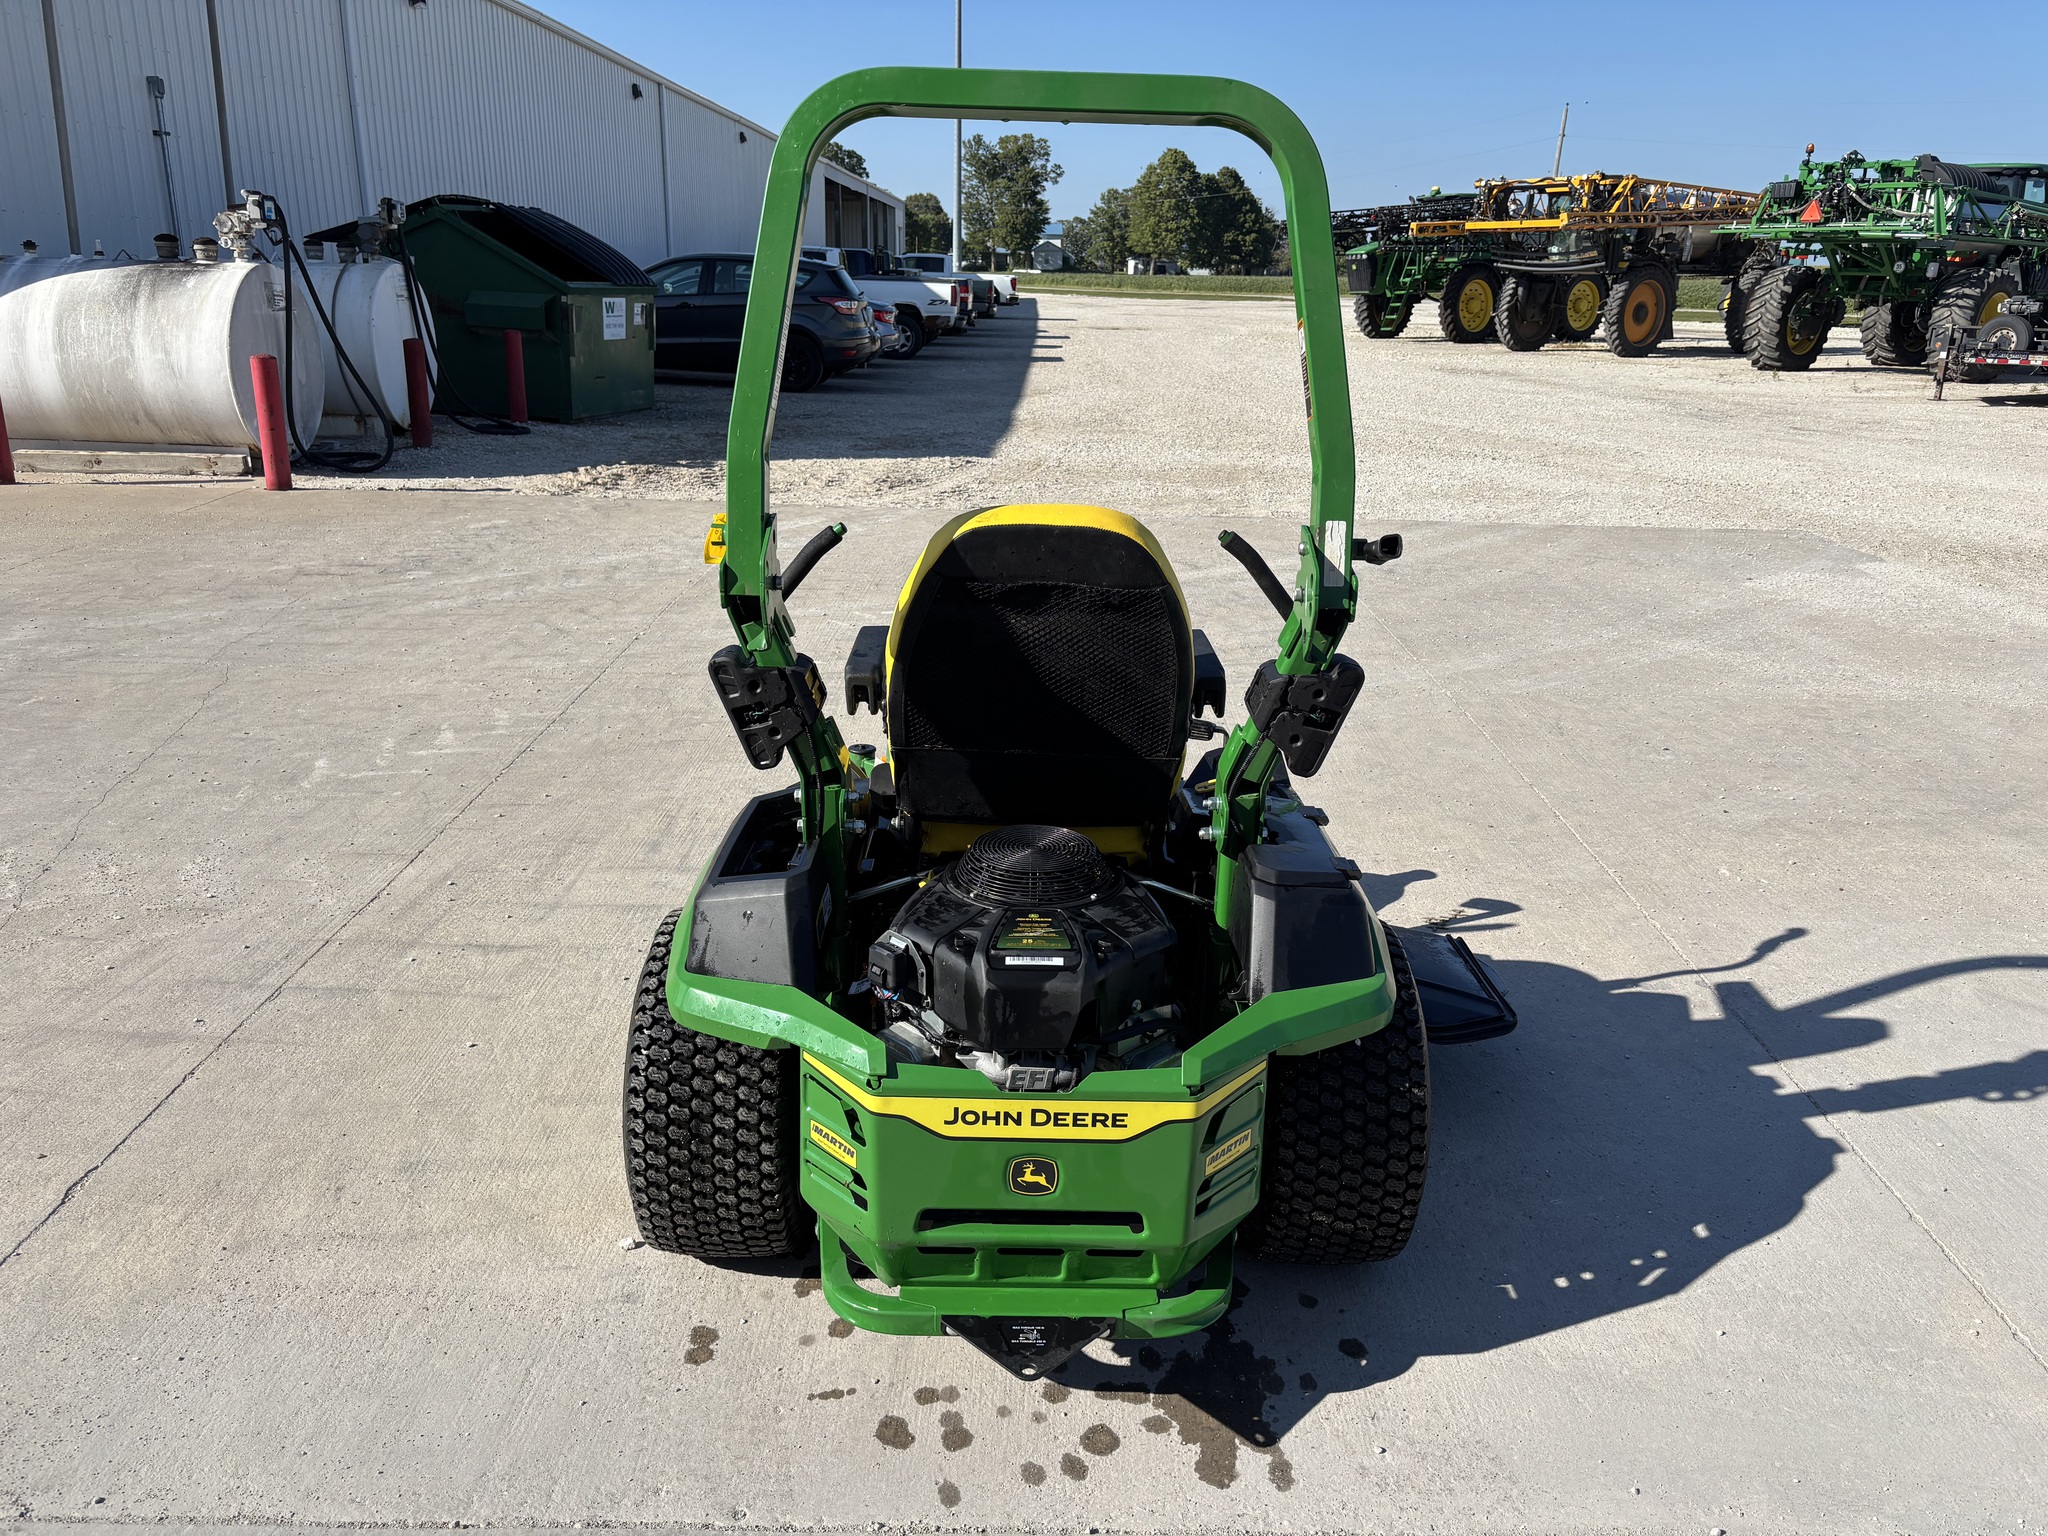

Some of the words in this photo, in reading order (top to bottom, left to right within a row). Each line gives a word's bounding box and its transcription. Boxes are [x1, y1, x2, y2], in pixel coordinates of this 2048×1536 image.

[1009, 1070, 1055, 1089] EFI
[943, 1106, 1022, 1127] JOHN
[1030, 1108, 1129, 1128] DEERE
[812, 1123, 856, 1159] MARTIN
[1207, 1131, 1250, 1167] MARTIN
